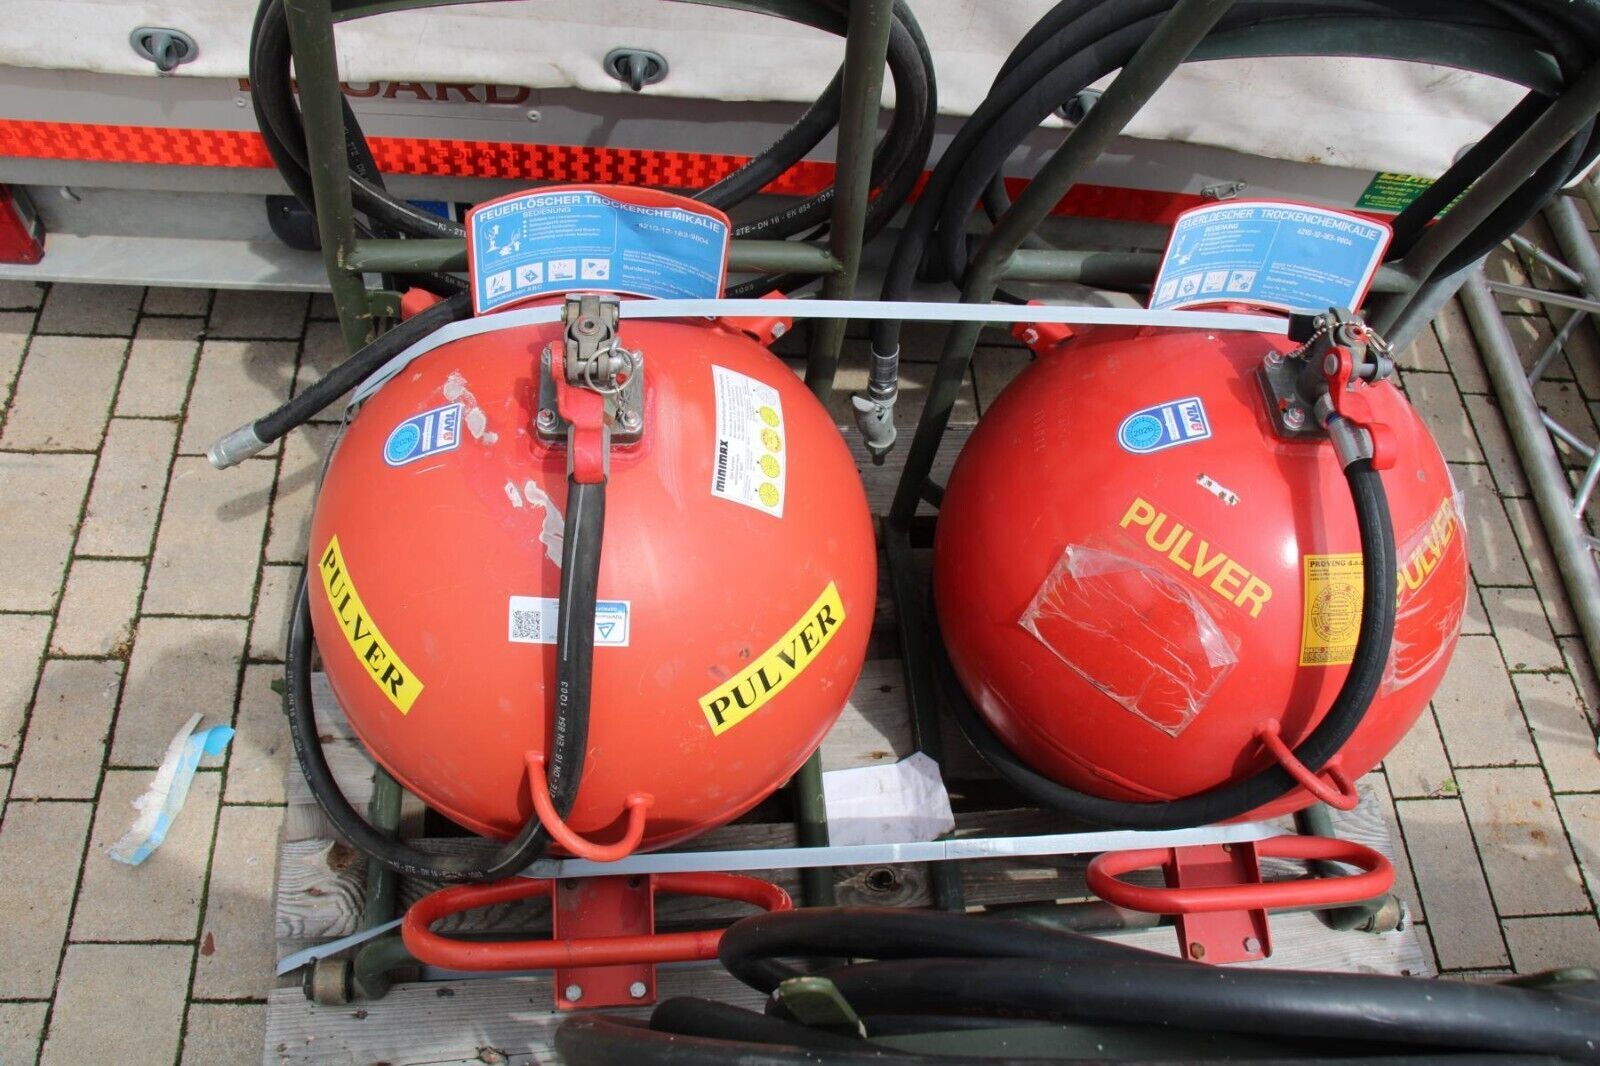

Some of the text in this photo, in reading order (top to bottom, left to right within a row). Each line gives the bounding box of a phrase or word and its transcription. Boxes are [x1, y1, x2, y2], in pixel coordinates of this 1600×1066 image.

[479, 195, 581, 223] FEUERLÖSCHER
[585, 194, 721, 234] TROCKENCHEMIKALIE
[522, 206, 572, 218] BEDIENUNG
[1261, 209, 1378, 241] TROCKENCHEMIKALIE
[1119, 497, 1273, 619] PULVER
[1309, 560, 1346, 568] PROVING
[322, 547, 405, 699] PULVER
[708, 604, 837, 727] PULVER
[556, 734, 565, 747] EN
[552, 764, 561, 778] DN
[555, 754, 563, 765] 16
